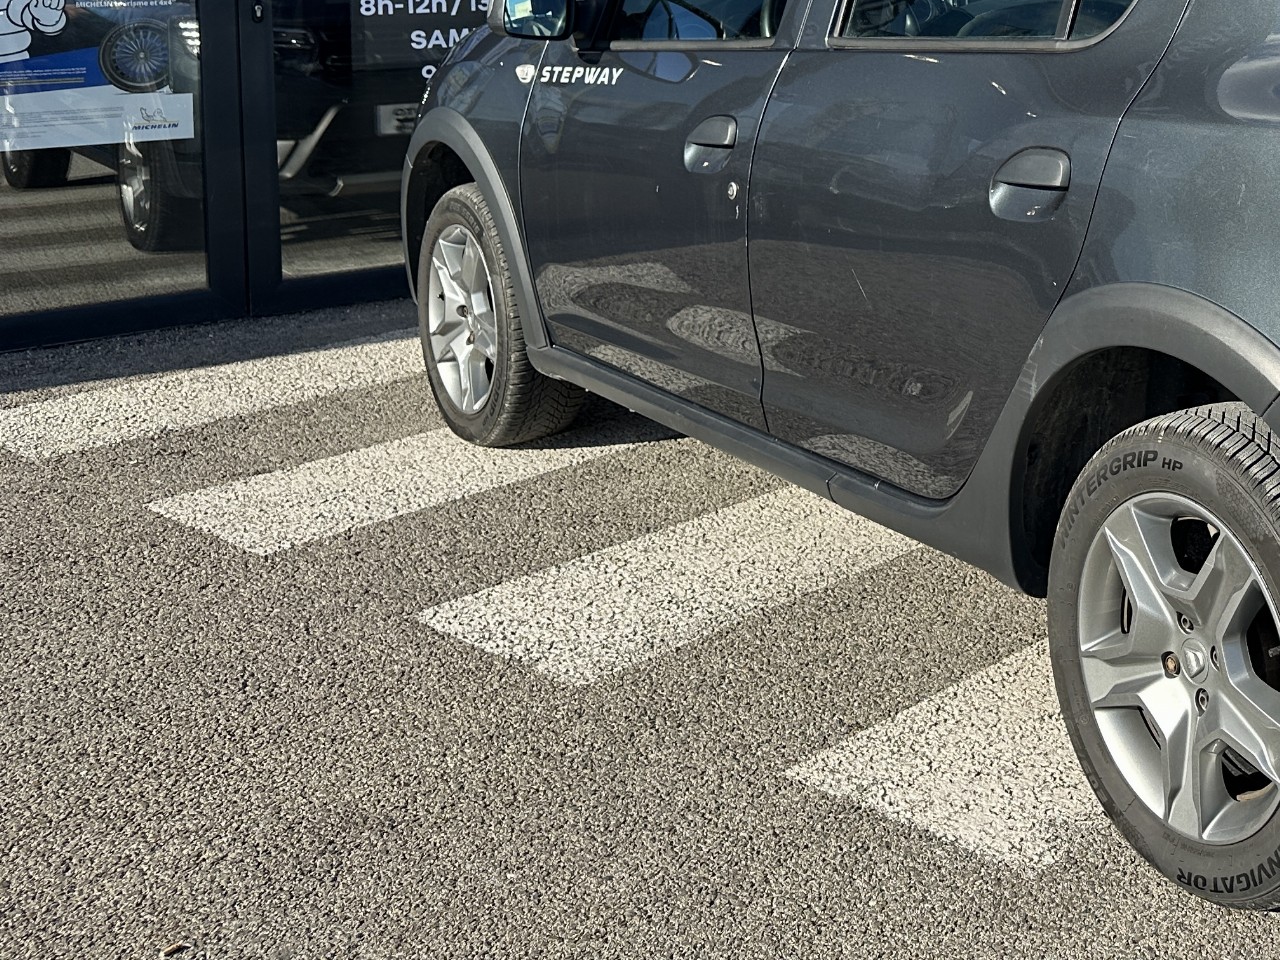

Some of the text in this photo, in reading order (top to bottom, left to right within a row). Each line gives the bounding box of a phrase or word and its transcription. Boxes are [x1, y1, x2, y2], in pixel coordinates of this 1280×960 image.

[410, 28, 472, 50] SAM
[540, 66, 624, 85] STEPWAY
[132, 122, 179, 131] MICHELIN
[1161, 457, 1184, 471] HP
